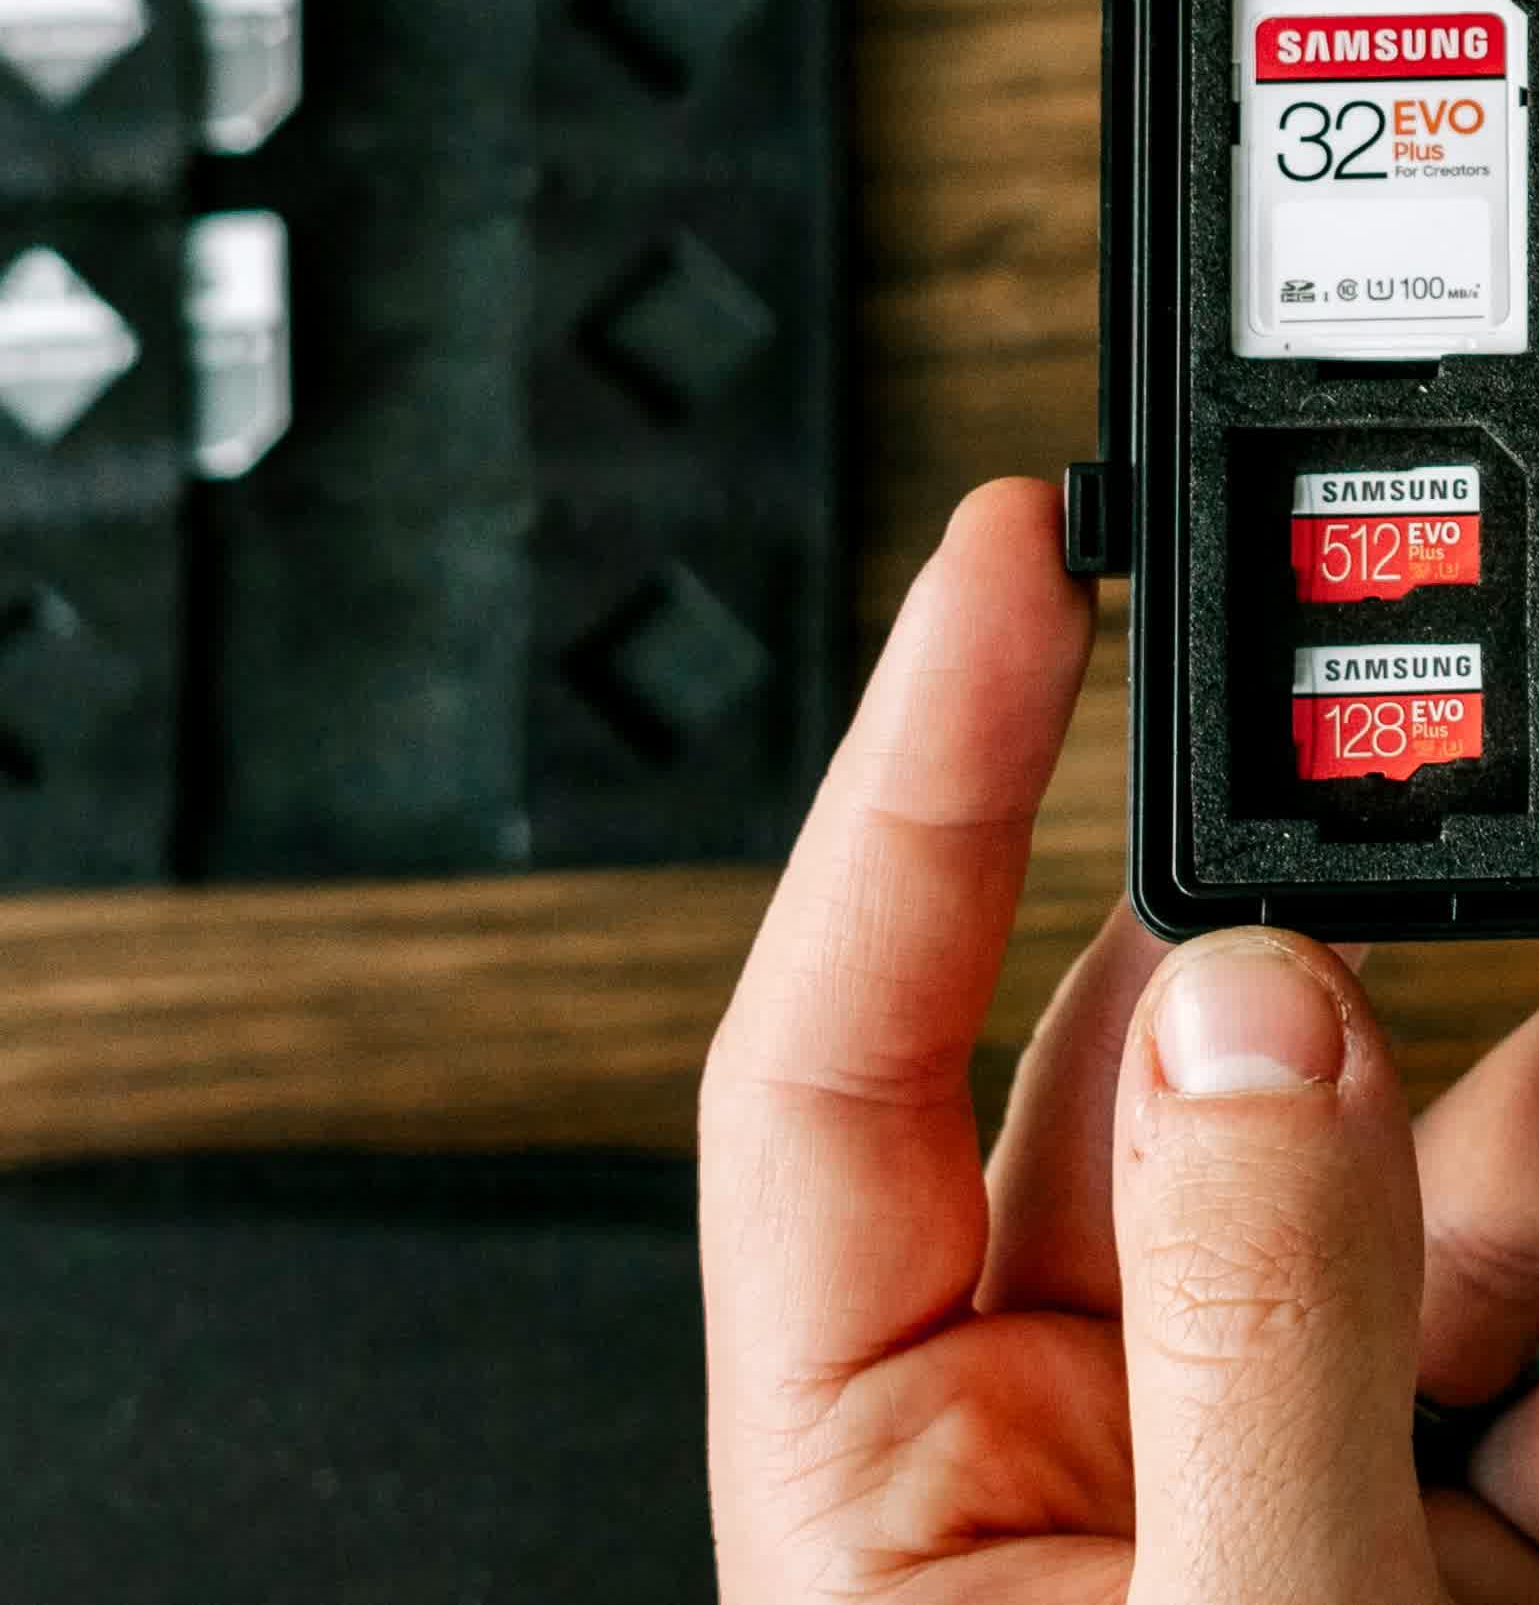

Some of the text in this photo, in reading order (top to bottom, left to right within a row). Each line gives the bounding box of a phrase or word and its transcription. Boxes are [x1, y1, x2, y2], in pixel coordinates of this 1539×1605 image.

[1277, 27, 1488, 64] SAMSUNG
[1278, 99, 1484, 182] 32 EVO
[1393, 142, 1444, 161] Plus
[1401, 276, 1444, 300] 100
[1322, 479, 1468, 503] SAMSUNG
[1321, 523, 1401, 582] 512
[1408, 521, 1461, 544] EVO
[1408, 545, 1445, 560] Plus
[1325, 656, 1471, 681] SAMSUNG
[1324, 702, 1407, 759] 128
[1412, 699, 1464, 722] EVO
[1412, 723, 1448, 738] Plus
